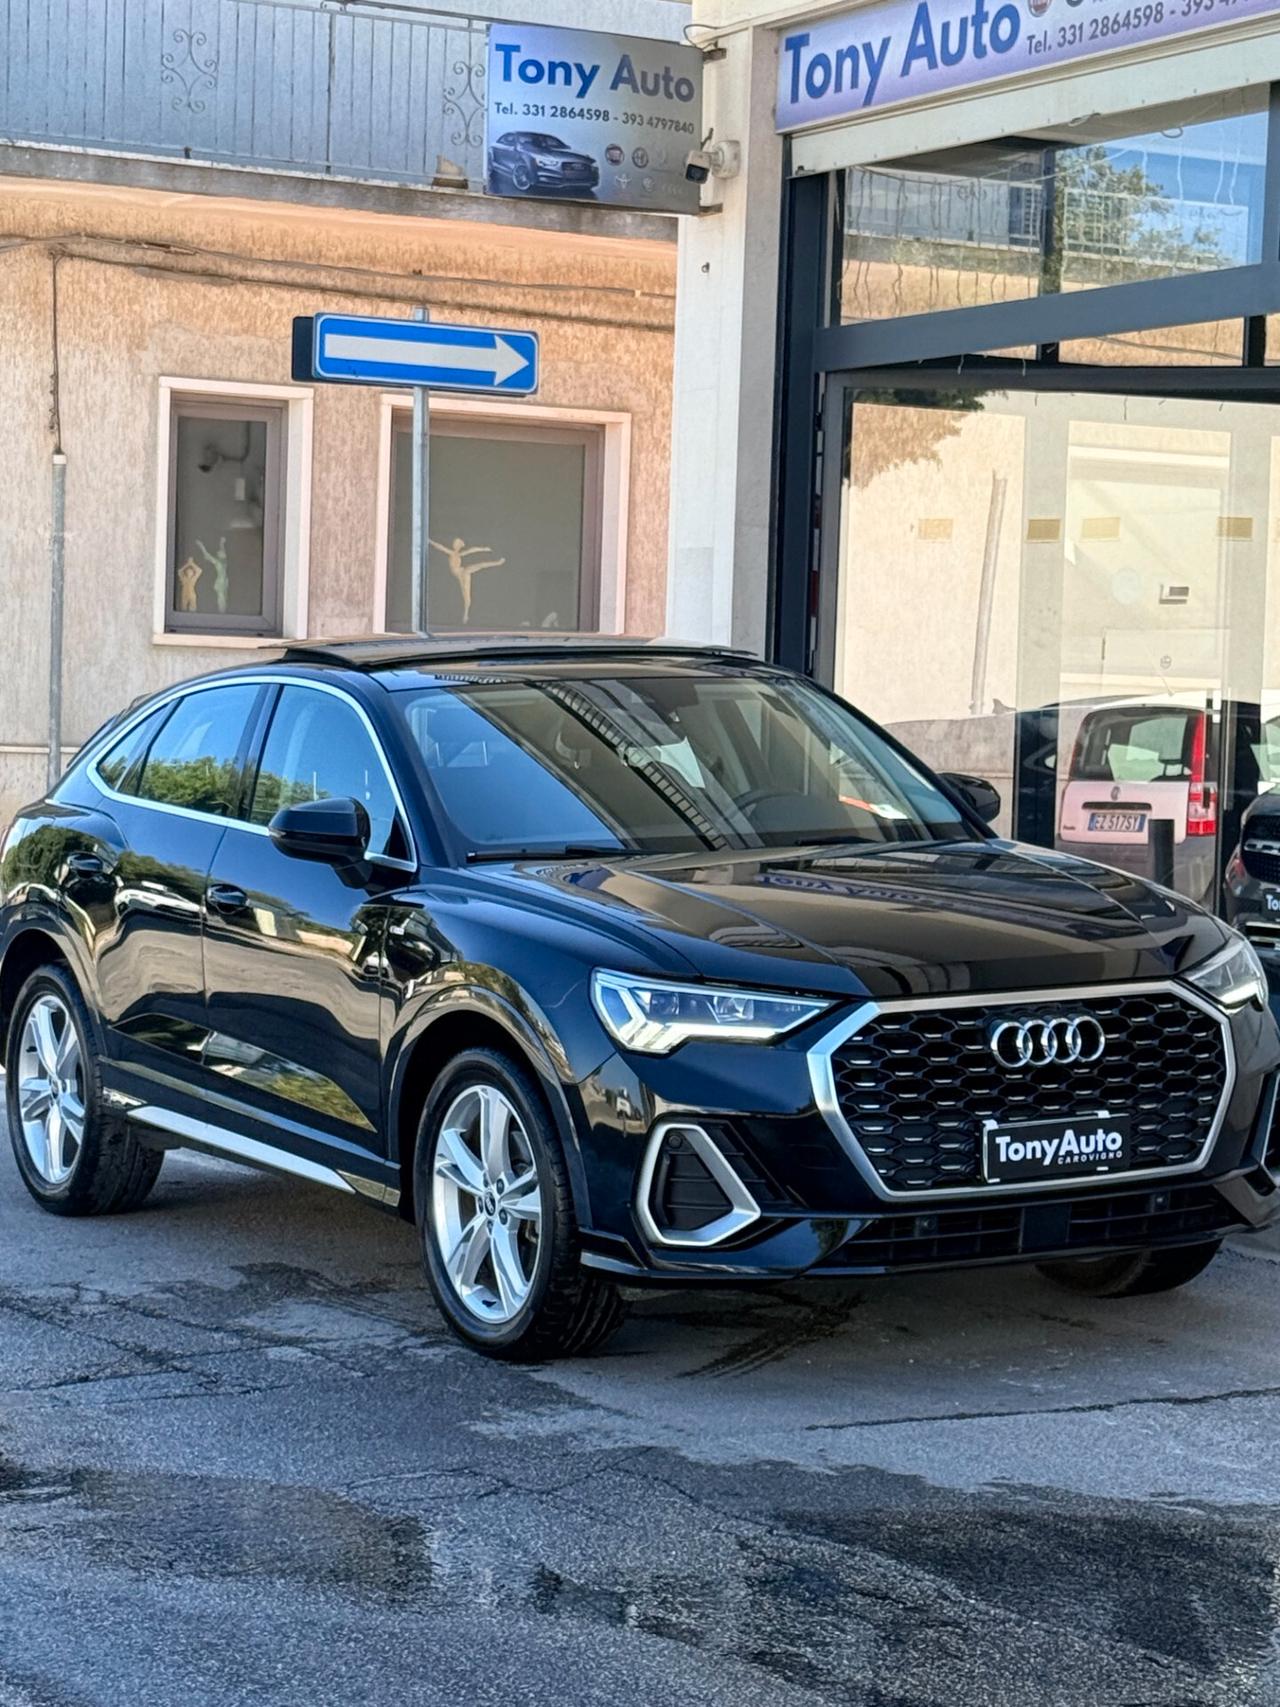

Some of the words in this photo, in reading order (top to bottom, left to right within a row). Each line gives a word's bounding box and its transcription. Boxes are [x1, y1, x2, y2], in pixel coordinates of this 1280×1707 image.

[1026, 30, 1052, 55] Tel.
[1057, 22, 1084, 48] 331
[1088, 2, 1164, 41] 2864598
[785, 32, 892, 107] Tony
[900, 0, 1021, 78] Auto
[495, 43, 600, 99] Tony
[609, 54, 695, 102] Auto
[494, 102, 518, 115] Tel.
[522, 103, 546, 117] 331
[550, 106, 610, 122] 2864598
[622, 112, 644, 127] 393
[646, 116, 695, 135] 4797840
[1265, 894, 1280, 911] To
[995, 1129, 1122, 1166] TonyAuto
[1057, 1151, 1123, 1165] CAROVIGNO
